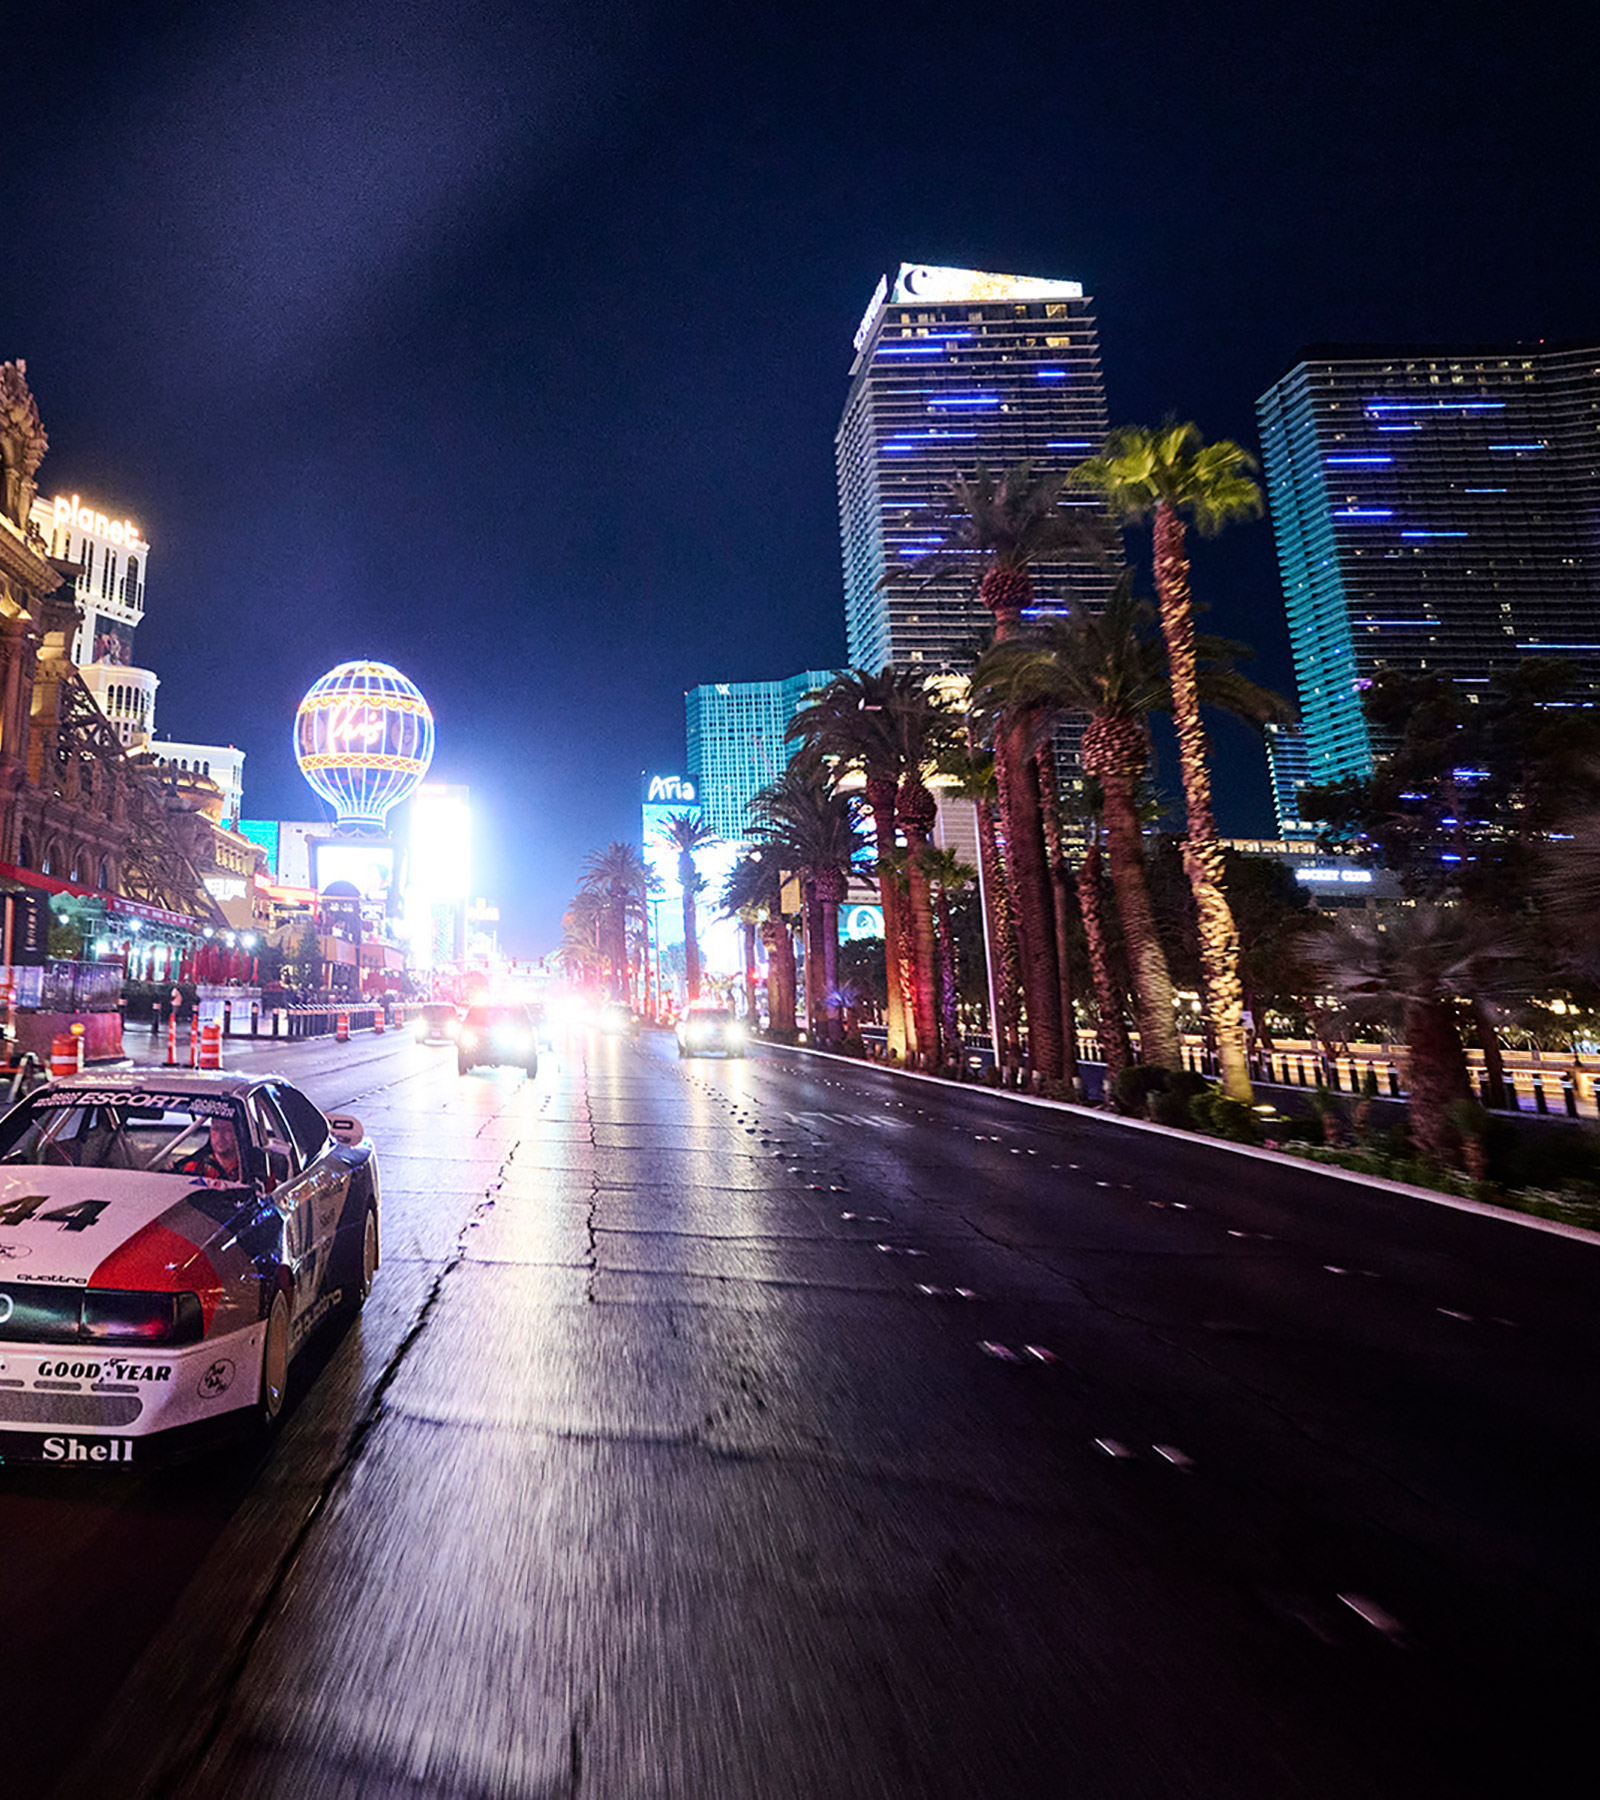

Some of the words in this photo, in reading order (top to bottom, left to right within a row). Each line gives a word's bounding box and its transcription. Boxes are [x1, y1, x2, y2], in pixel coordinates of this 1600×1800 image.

[53, 494, 139, 550] planet
[648, 775, 696, 801] Aria
[76, 1092, 190, 1108] ESCORT
[16, 1273, 88, 1285] quattro
[42, 1437, 133, 1461] Shell
